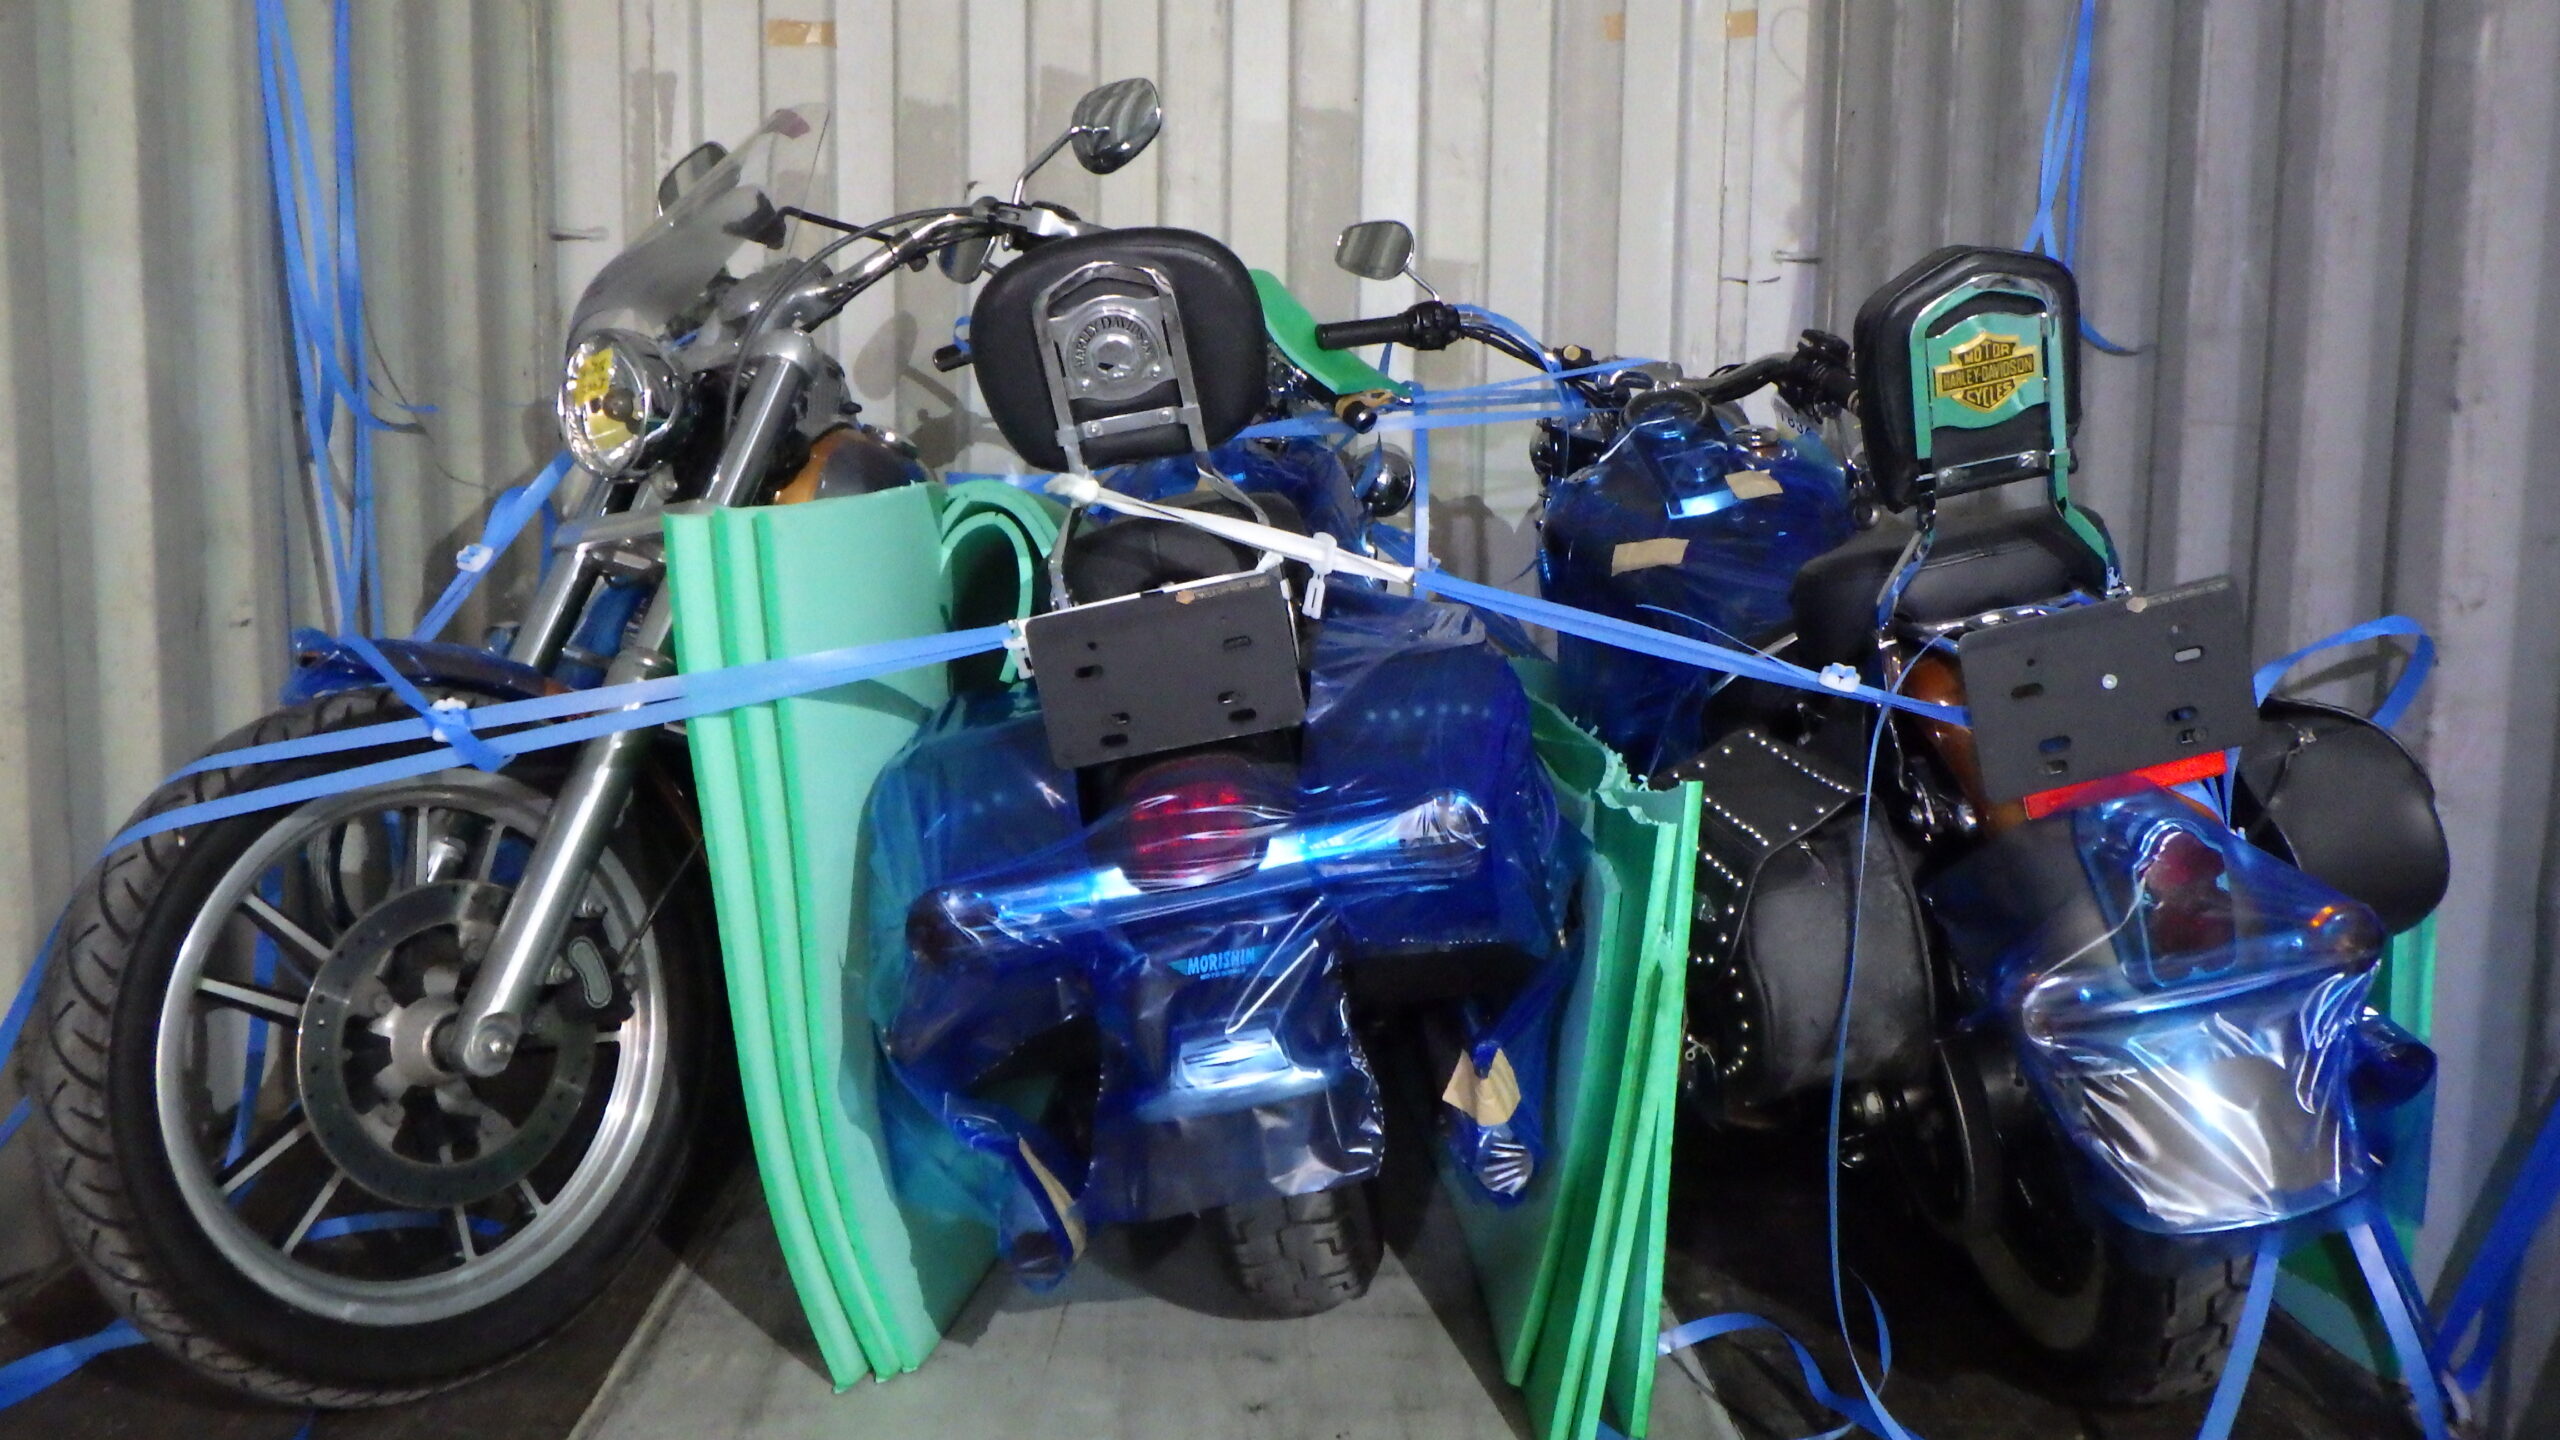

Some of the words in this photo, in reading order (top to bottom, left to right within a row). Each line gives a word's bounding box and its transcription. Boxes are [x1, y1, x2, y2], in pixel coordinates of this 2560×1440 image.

[1963, 341, 2010, 364] MOTOR
[1941, 354, 2034, 389] HARLEY-DAVIDSON
[1966, 381, 2013, 408] CYCLES
[1187, 947, 1256, 976] MORISHIN
